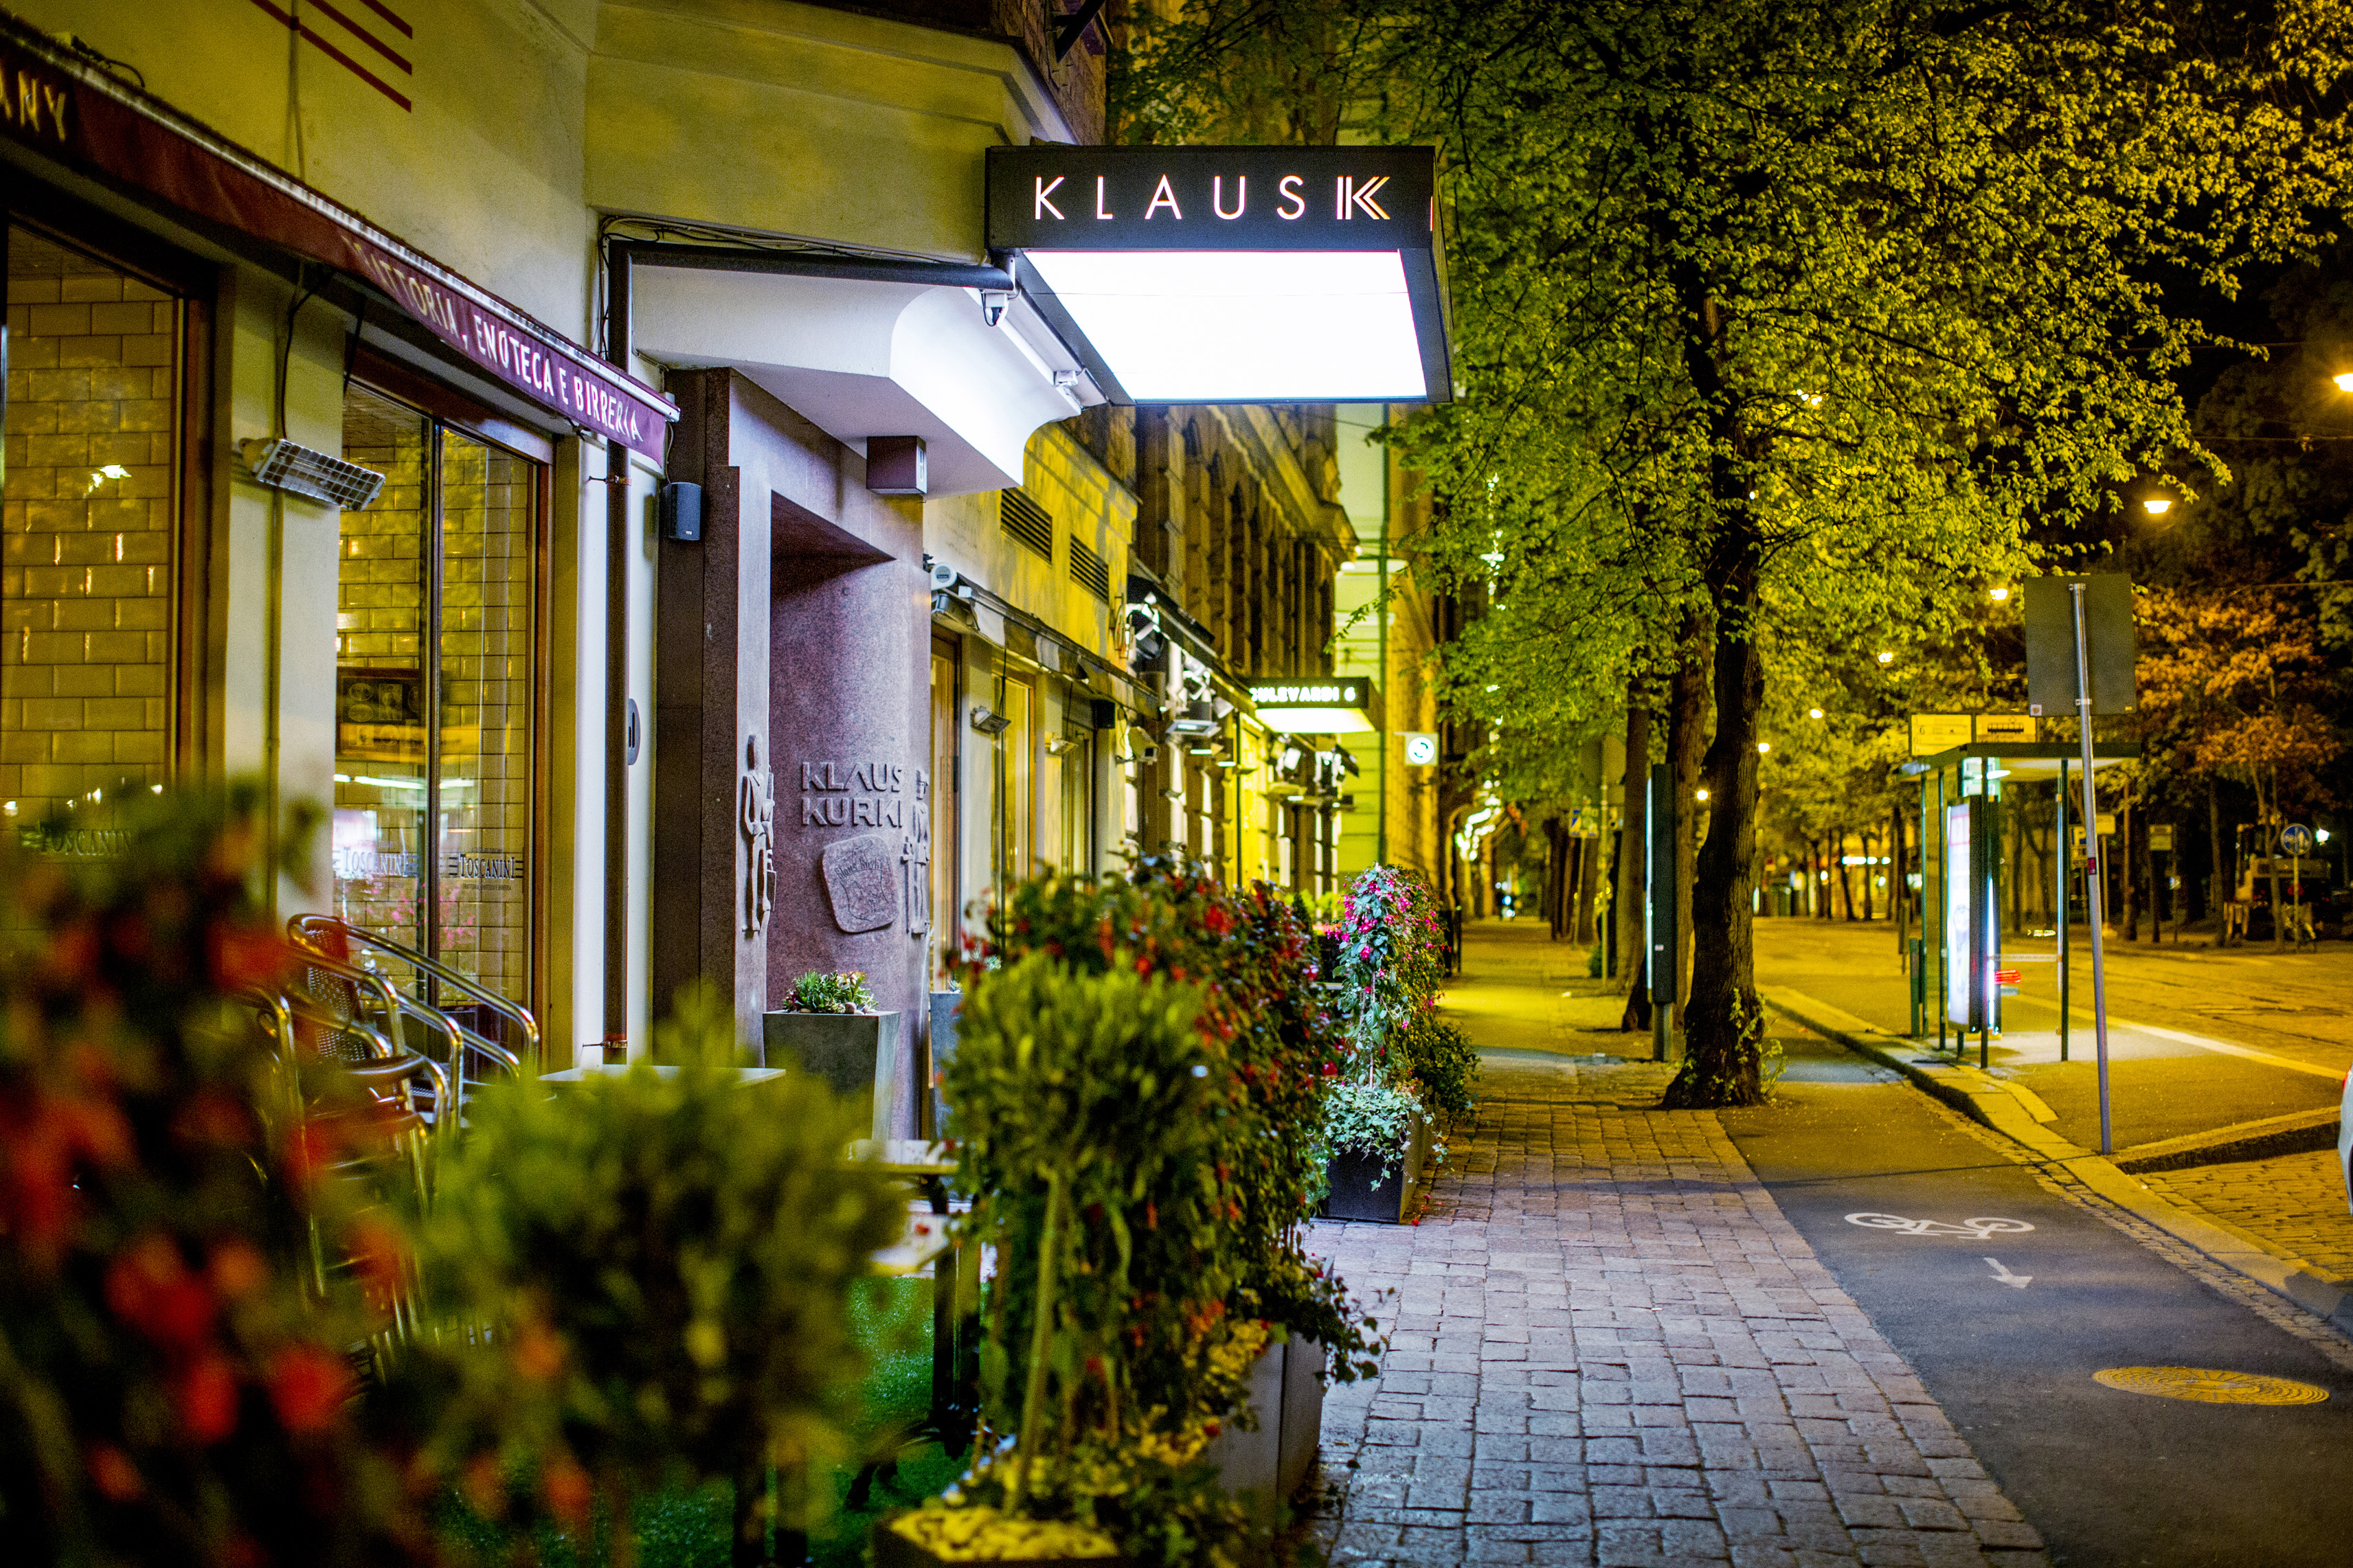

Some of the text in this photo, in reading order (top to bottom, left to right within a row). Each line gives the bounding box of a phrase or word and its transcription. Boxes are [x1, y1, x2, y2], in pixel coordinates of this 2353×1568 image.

[1035, 174, 1305, 220] KLAUS
[474, 315, 554, 390] ENOTECA
[559, 367, 569, 405] E
[574, 376, 644, 442] BIRRERIA
[1344, 687, 1356, 701] 6
[802, 761, 903, 792] KLAUS
[802, 797, 903, 828] KURKI
[458, 852, 515, 880] TOSCANINI
